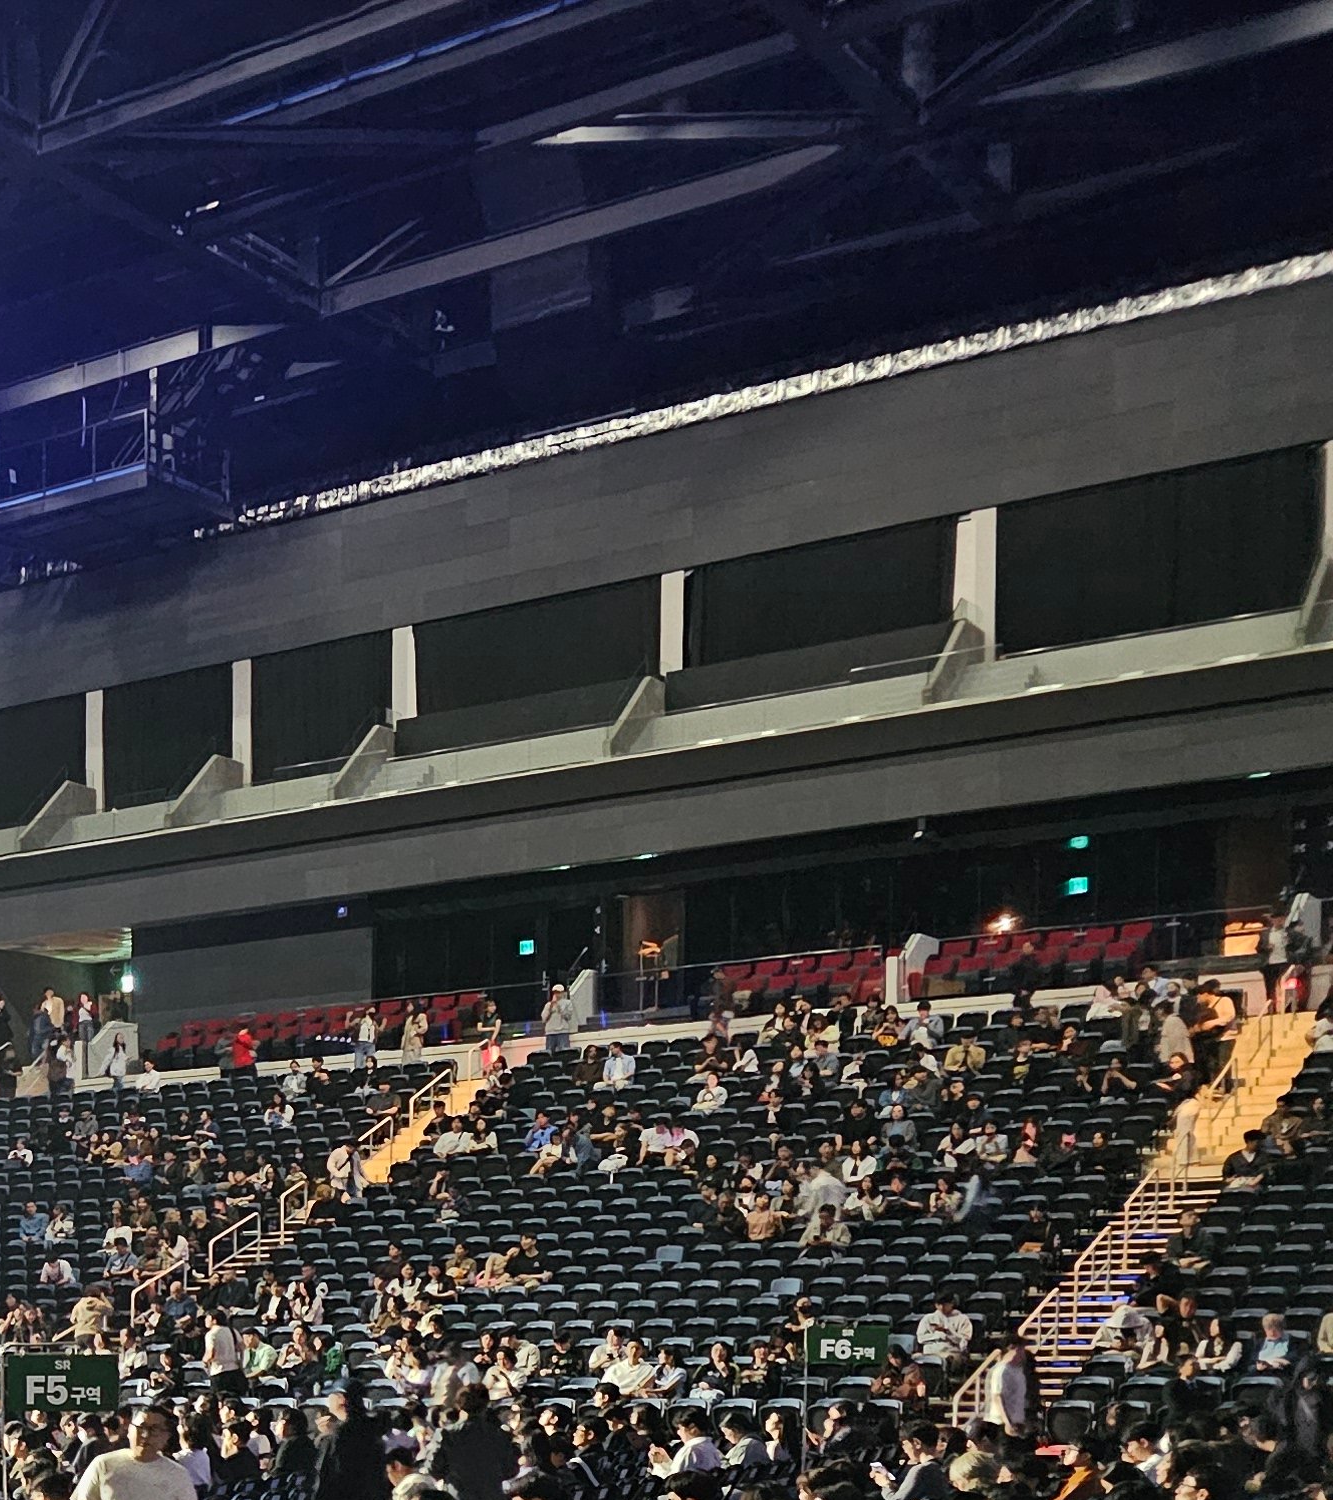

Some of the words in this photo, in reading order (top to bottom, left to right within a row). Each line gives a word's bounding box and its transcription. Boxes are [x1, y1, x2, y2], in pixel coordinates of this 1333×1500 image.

[819, 1338, 875, 1361] F6구역
[54, 1359, 71, 1371] SR
[26, 1375, 101, 1406] F5구역
